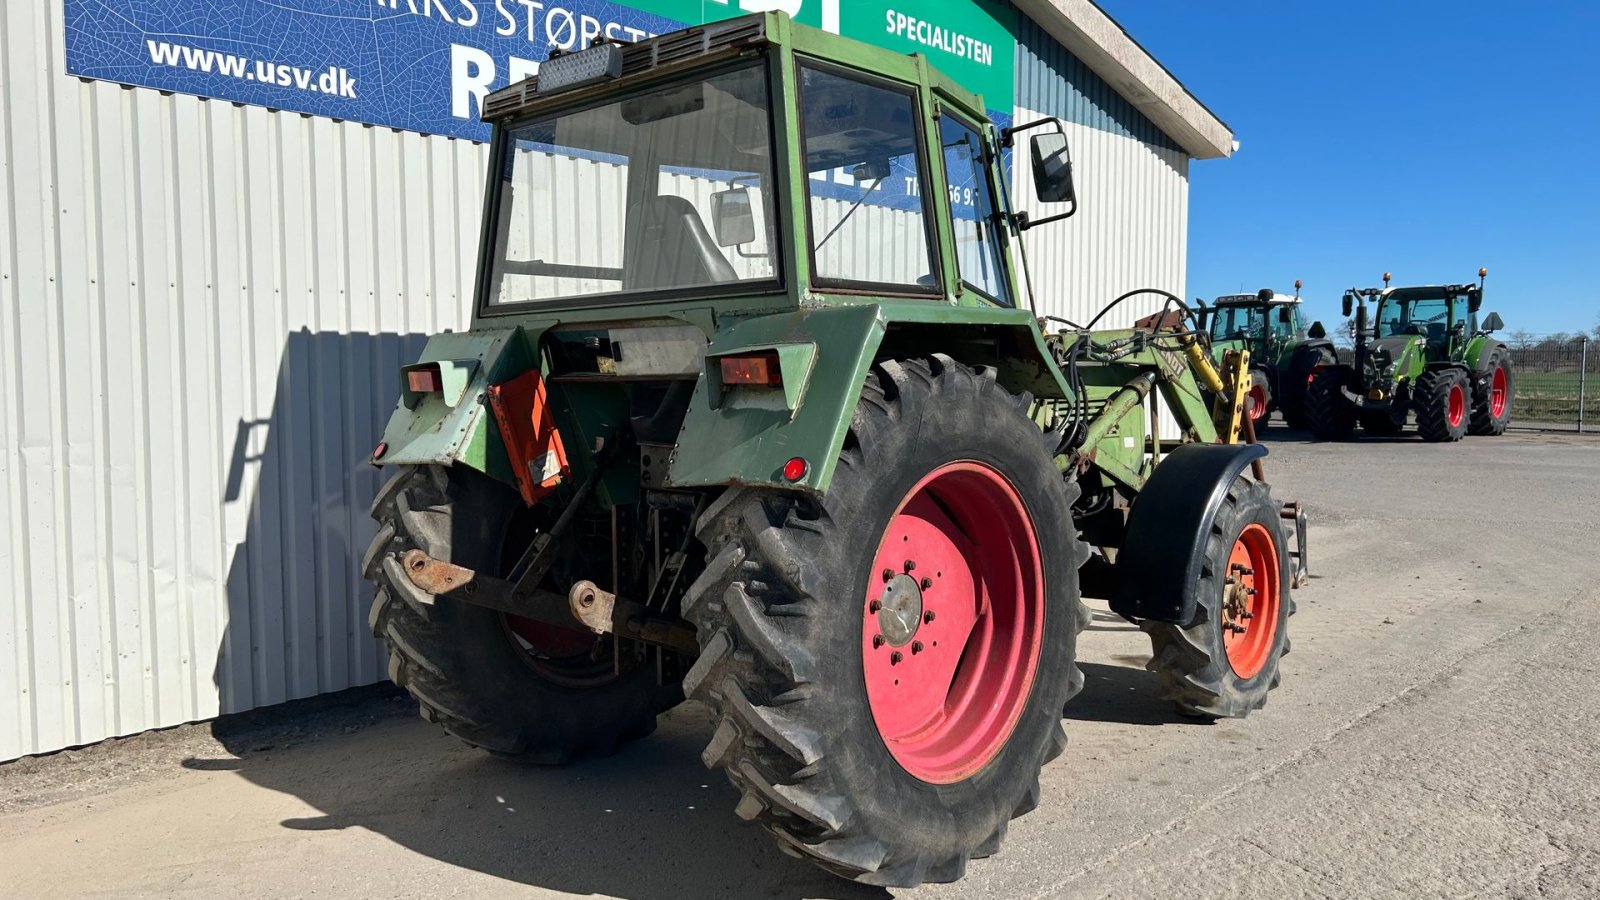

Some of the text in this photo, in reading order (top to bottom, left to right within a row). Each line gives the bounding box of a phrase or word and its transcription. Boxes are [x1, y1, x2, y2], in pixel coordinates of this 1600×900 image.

[495, 0, 660, 50] STØRST
[886, 9, 992, 66] SPECIALISTEN
[147, 40, 357, 98] www.usv.dk
